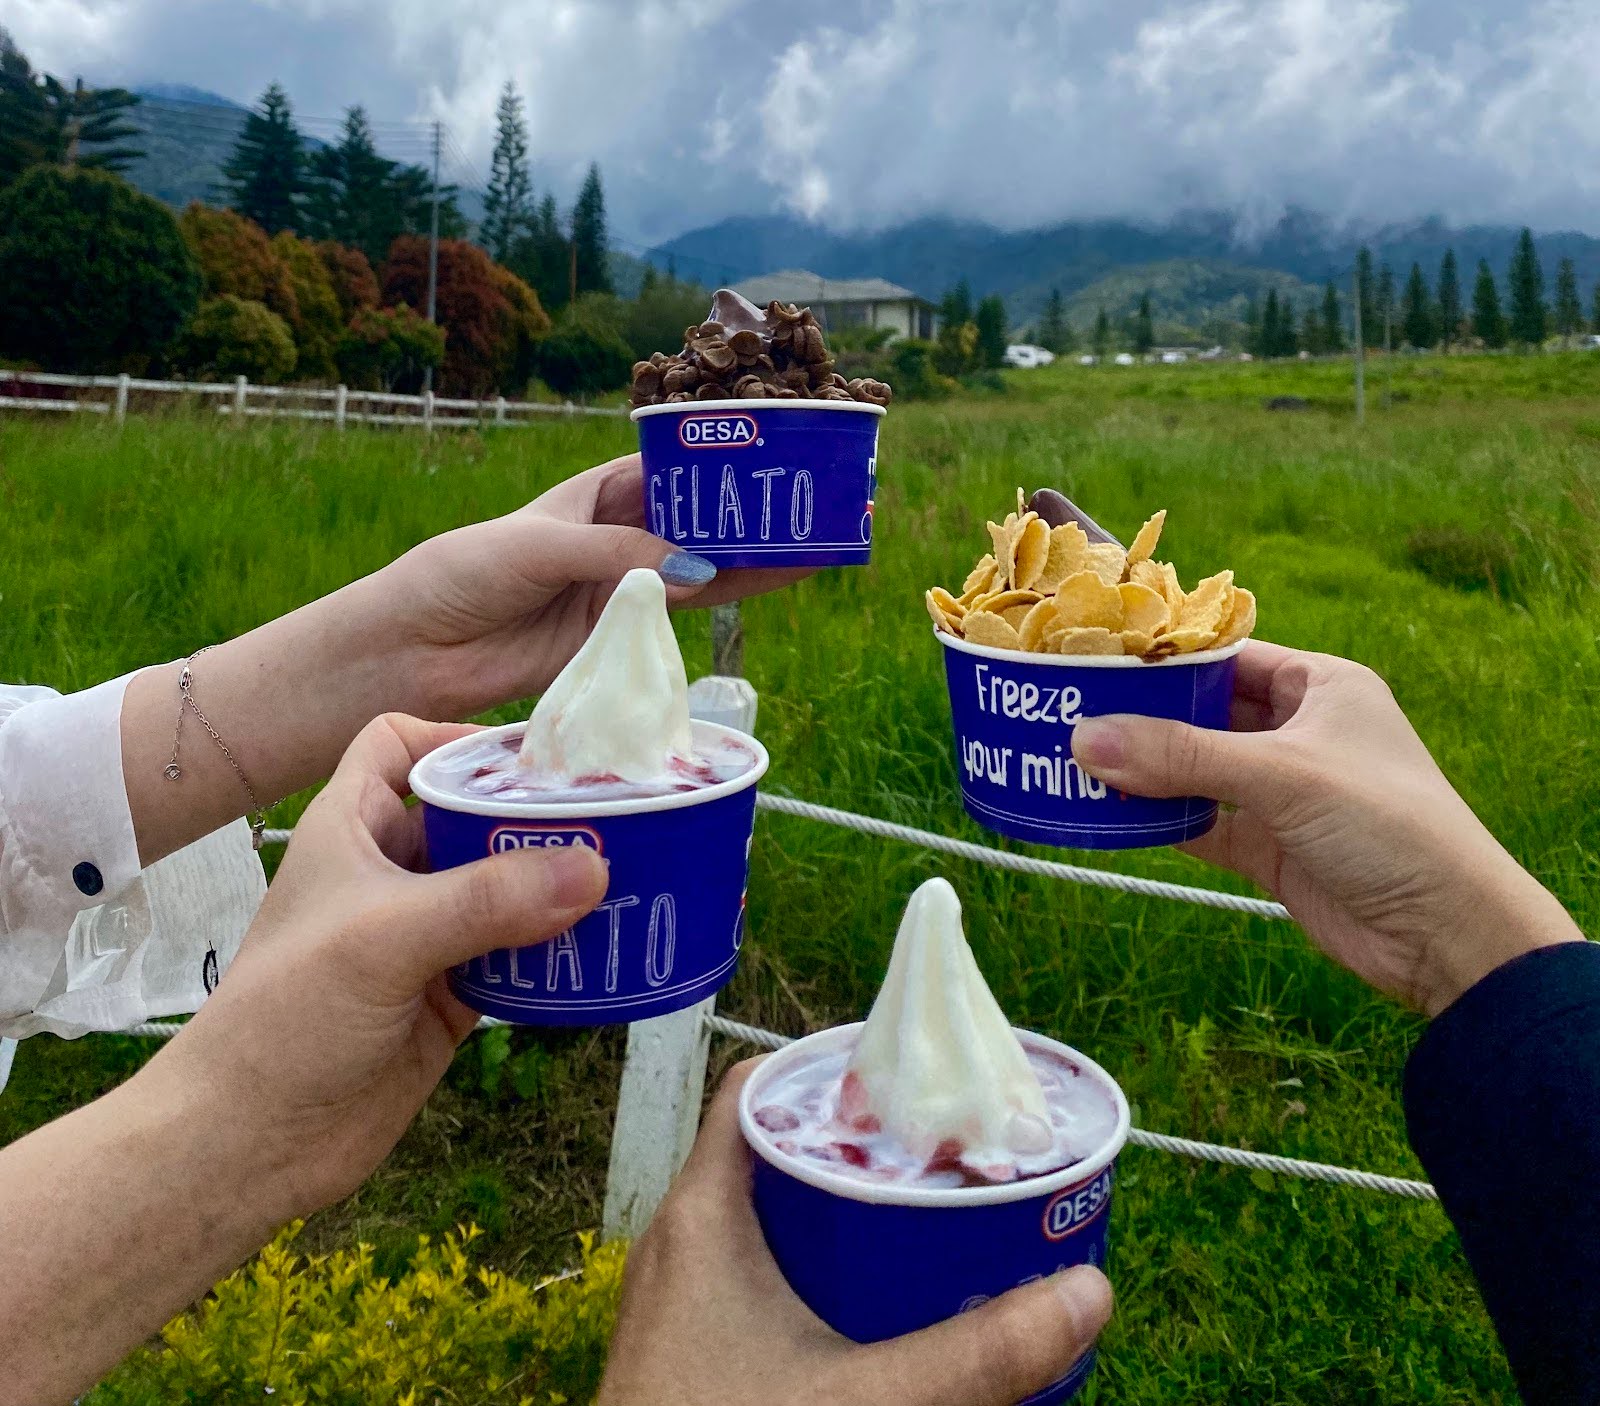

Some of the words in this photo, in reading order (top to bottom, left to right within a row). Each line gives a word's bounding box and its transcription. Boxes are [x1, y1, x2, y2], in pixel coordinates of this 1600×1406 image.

[686, 420, 750, 442] DESA
[650, 464, 814, 541] GELATO
[975, 664, 1083, 726] Freeze
[962, 735, 1013, 787] your
[456, 893, 677, 993] ATO
[1053, 1173, 1111, 1231] DESA
